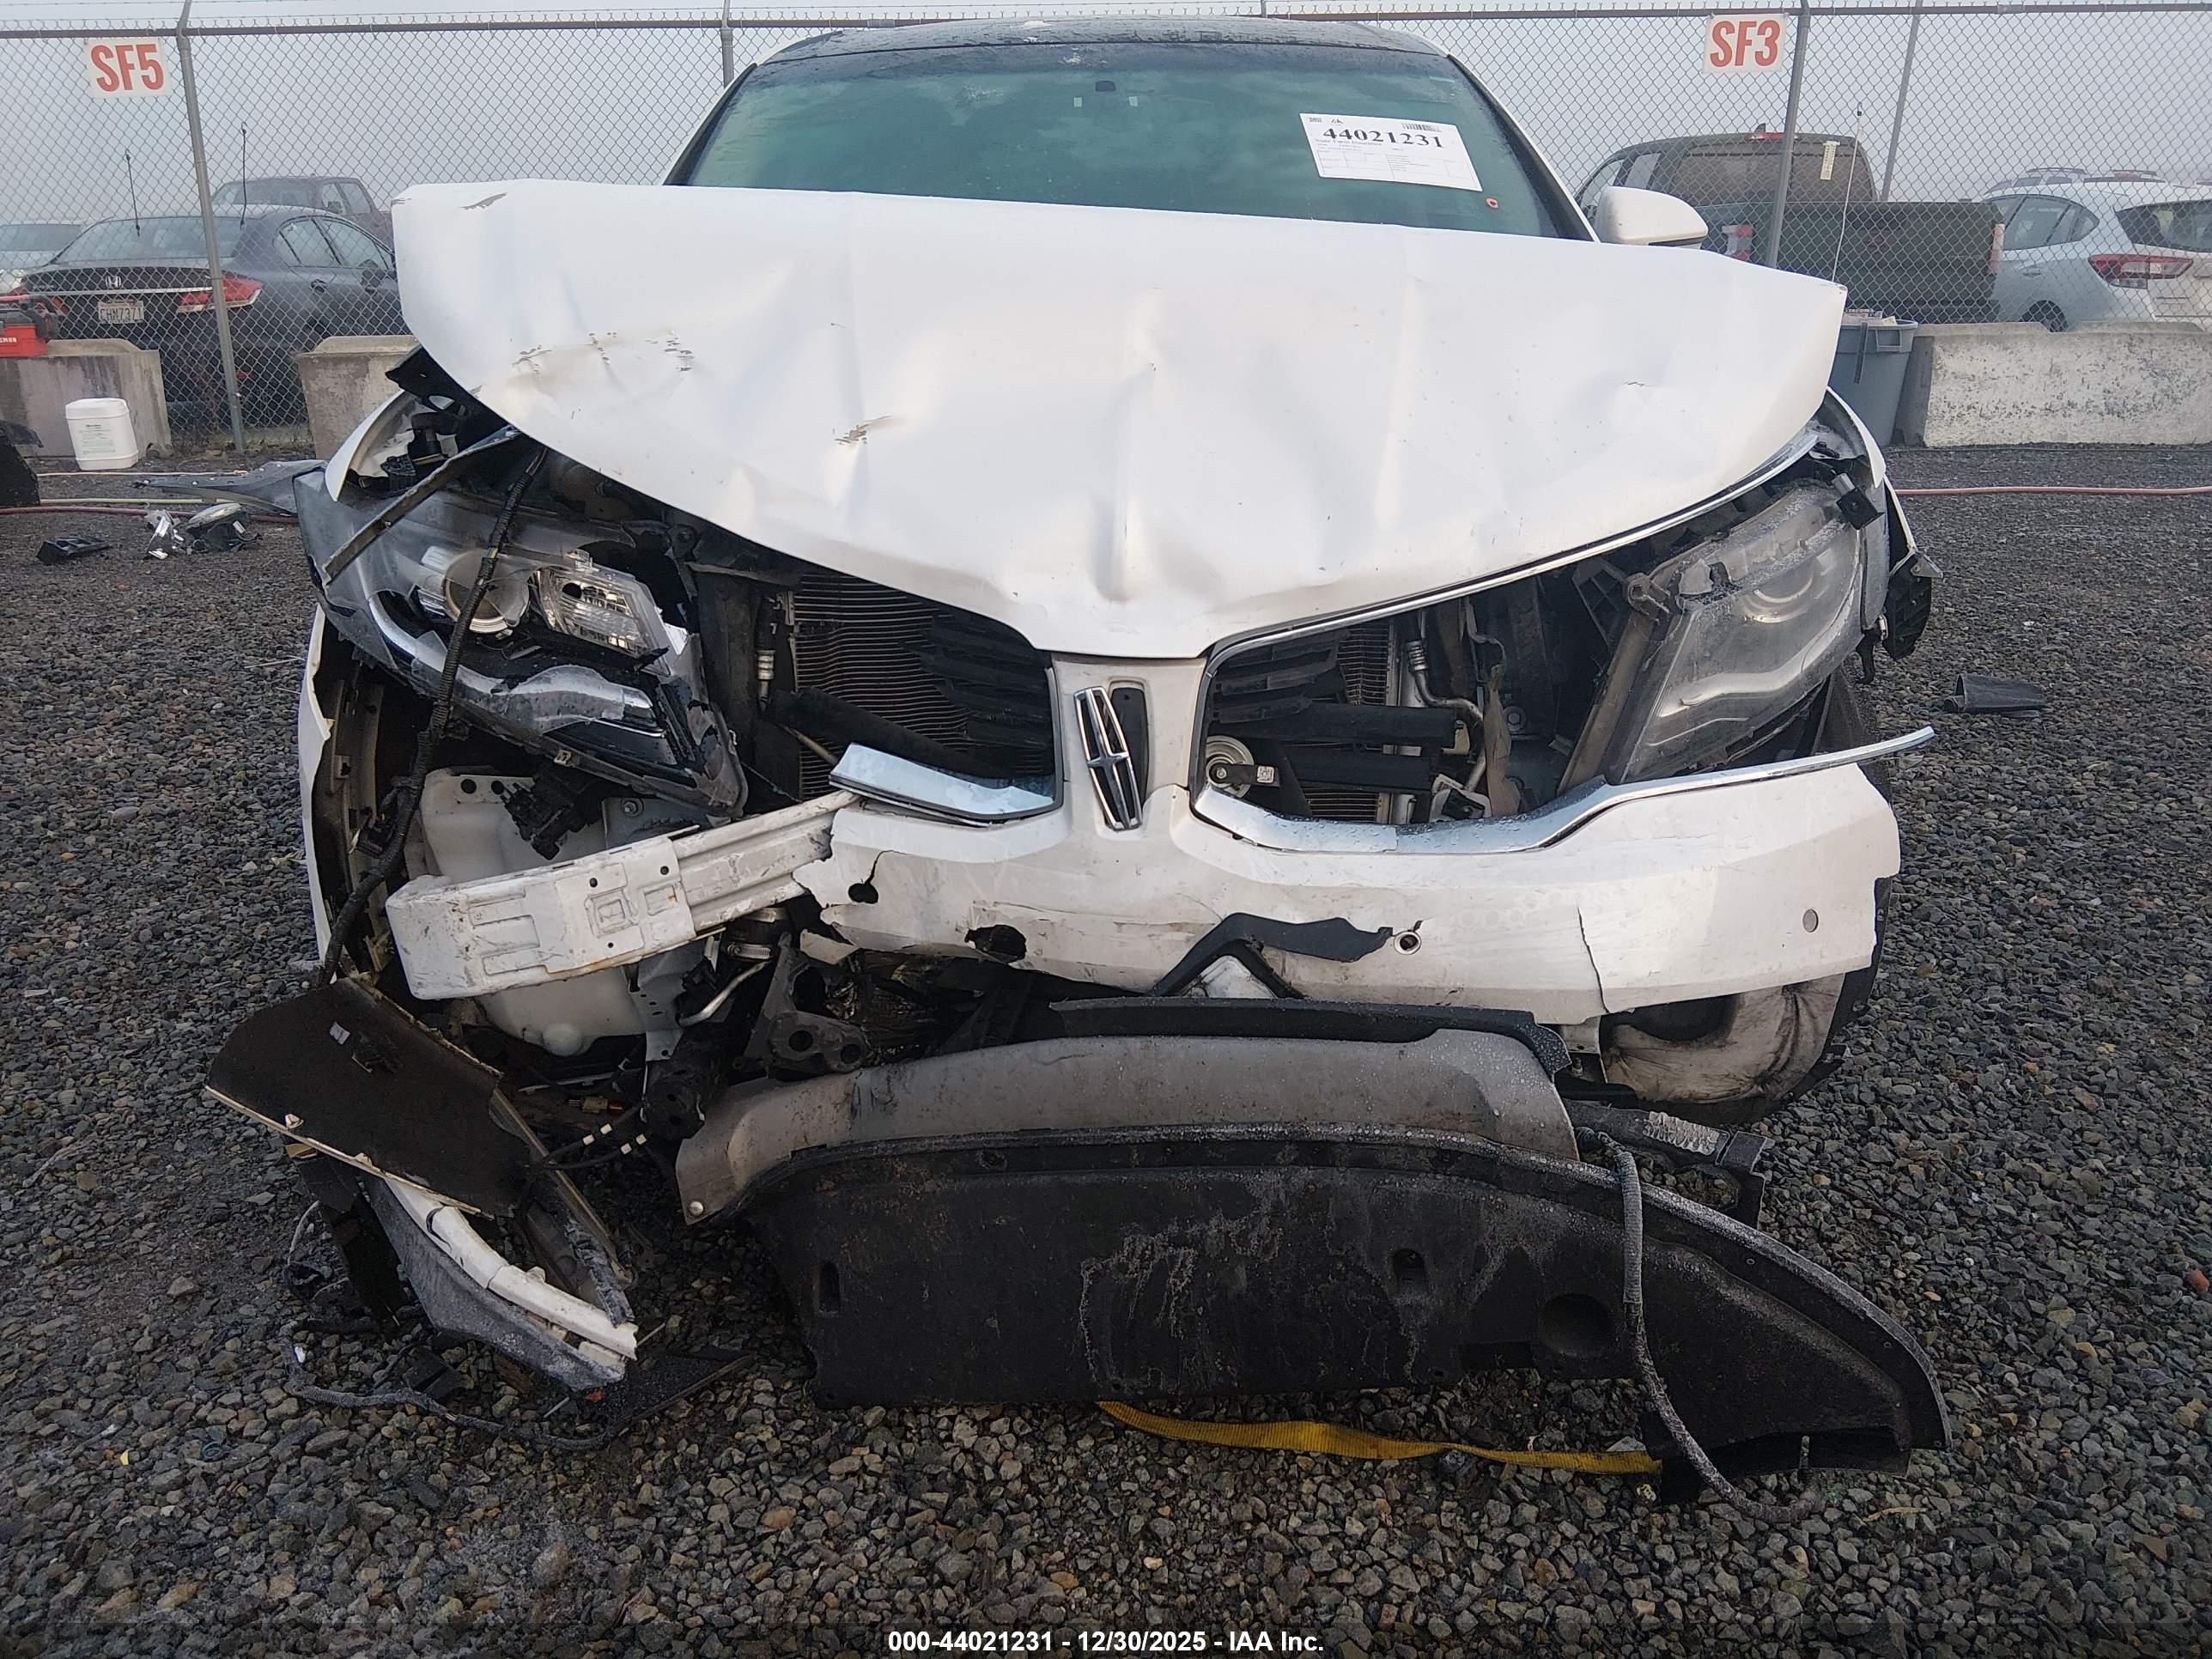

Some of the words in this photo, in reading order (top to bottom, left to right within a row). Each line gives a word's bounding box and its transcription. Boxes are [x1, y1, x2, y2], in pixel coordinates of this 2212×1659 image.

[1710, 20, 1781, 67] SF3
[90, 44, 164, 92] SF5
[1322, 128, 1443, 149] 44021231
